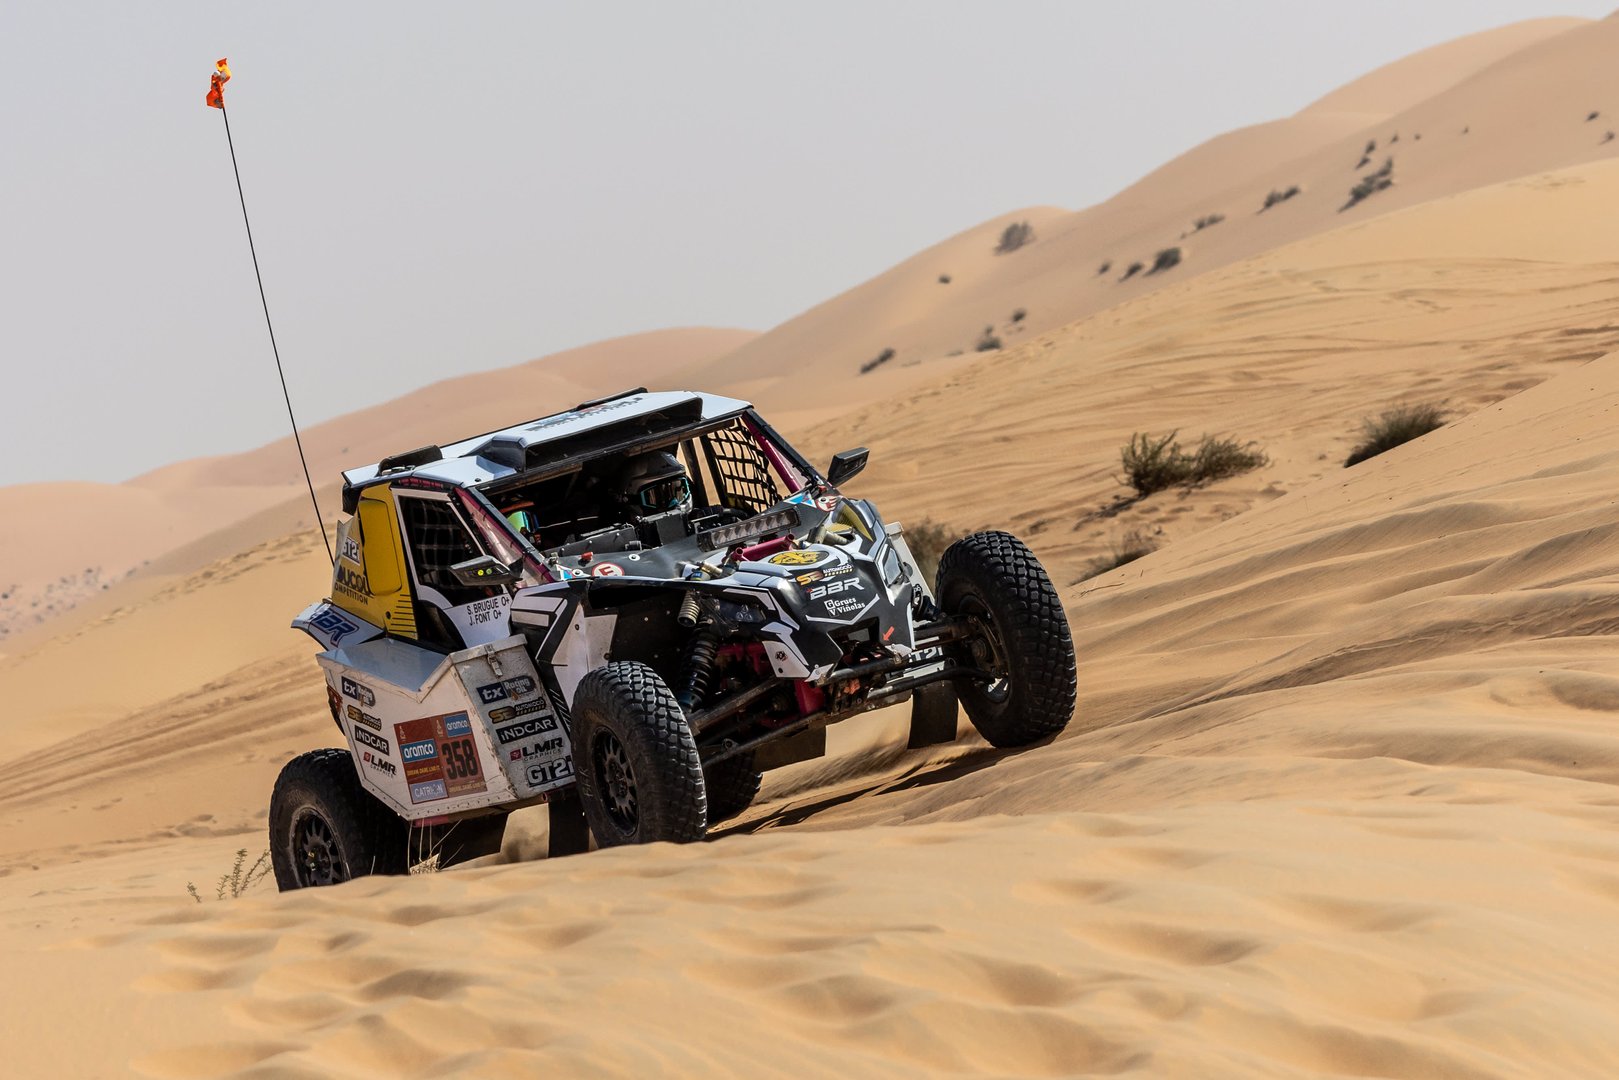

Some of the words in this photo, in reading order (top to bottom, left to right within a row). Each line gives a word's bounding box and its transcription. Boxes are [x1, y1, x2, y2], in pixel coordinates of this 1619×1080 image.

[335, 582, 368, 605] OMPETITION
[810, 577, 864, 600] BBR
[466, 605, 473, 615] S.
[473, 598, 499, 613] BRUGUE
[837, 603, 865, 614] Viñolas
[469, 616, 475, 626] J.
[475, 611, 490, 624] FONT
[344, 682, 356, 696] tx
[482, 687, 503, 700] tx
[446, 720, 468, 731] aramco
[404, 743, 434, 758] aramco
[522, 737, 563, 757] LMR
[441, 739, 478, 780] 358
[524, 748, 564, 762] GRAPHICS
[370, 755, 397, 775] LMR
